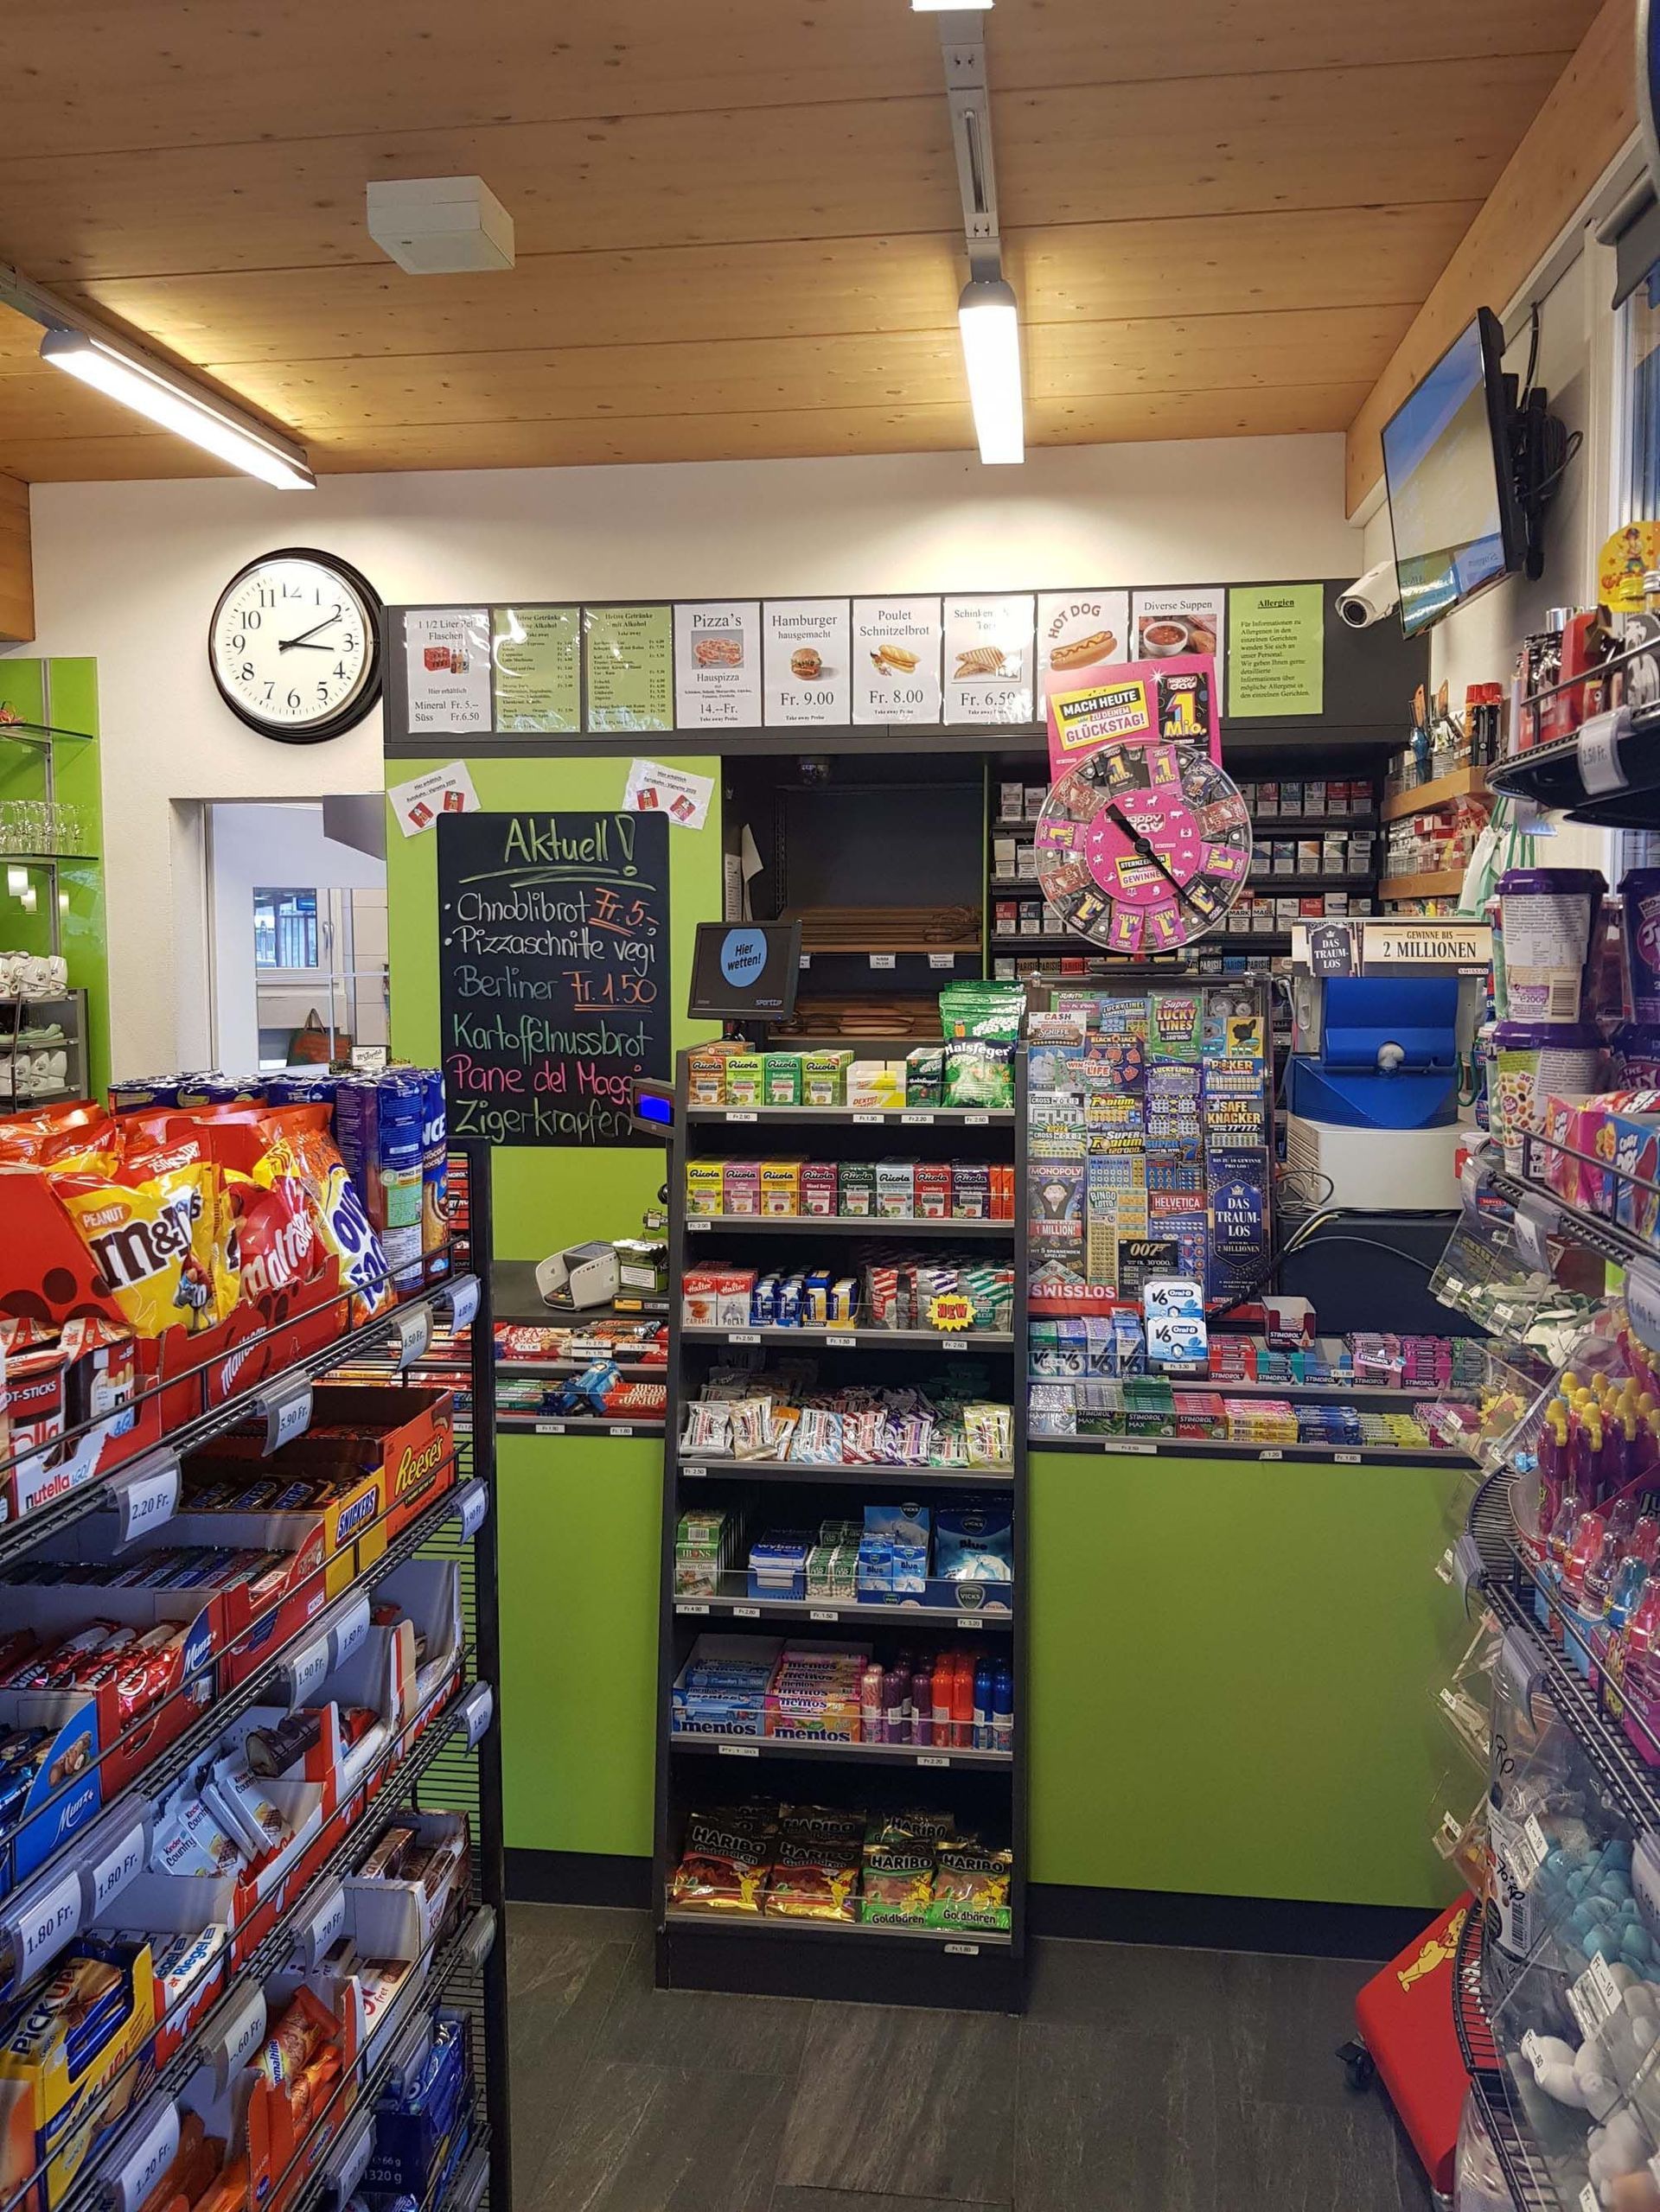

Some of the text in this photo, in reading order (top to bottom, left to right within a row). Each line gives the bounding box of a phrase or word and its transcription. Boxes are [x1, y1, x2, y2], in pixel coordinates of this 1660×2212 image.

[259, 589, 277, 608] 11
[316, 588, 322, 606] 1
[1257, 598, 1294, 609] Allergien
[1144, 600, 1212, 611] Diverse Suppen
[240, 610, 262, 630] 10
[331, 604, 342, 622] 2
[878, 610, 912, 621] Poulet
[693, 613, 742, 628] Pizza's
[772, 614, 838, 628] Hamburger
[1048, 602, 1102, 640] HOT DOG
[429, 631, 464, 641] Flaschen
[778, 630, 831, 641] hausgemacht
[859, 625, 929, 637] Schnitzelbrot
[232, 634, 246, 655] 9
[342, 633, 354, 652] 3
[241, 662, 255, 681] 8
[333, 660, 346, 679] 4
[696, 673, 740, 684] Hauspizza
[264, 681, 276, 700] 7
[316, 681, 329, 701] 5
[869, 691, 923, 704] Fr. 8.00
[287, 688, 301, 709] 6
[415, 700, 446, 711] Mineral
[450, 700, 463, 710] Fr.
[781, 692, 834, 705] Fr. 9.00
[961, 692, 980, 706] Fr.
[1063, 690, 1138, 717] MACH HEUTE
[1165, 692, 1197, 724] 1
[415, 711, 480, 723] Süss Fr.6.50
[1066, 713, 1146, 743] GLÜCKSTAG!
[1165, 718, 1208, 738] Mio.
[1407, 931, 1453, 940] GEWINNE BIS
[735, 942, 754, 957] Hier
[1322, 938, 1340, 949] DAS
[1383, 940, 1477, 959] 2 MILLIONEN
[613, 928, 656, 978] vegi
[1314, 948, 1349, 959] TRAUM-
[727, 953, 761, 972] wetten!
[1324, 958, 1341, 969] LOS
[453, 964, 658, 1004] Berliner Fr. 1.50
[1103, 1001, 1146, 1013] LUCKY LINES
[1163, 999, 1191, 1010] Super
[1044, 1012, 1072, 1021] CASH
[1157, 1008, 1197, 1021] LUCKY
[1159, 1020, 1193, 1031] LINES
[453, 1011, 654, 1066] Kartoffelnussbrot
[945, 1042, 1010, 1060] Halsfeger
[693, 1061, 722, 1071] Ricola
[728, 1060, 759, 1070] Ricola
[767, 1060, 798, 1069] Ricola
[806, 1061, 837, 1071] Ricola
[1067, 1061, 1084, 1069] WIN
[1087, 1067, 1110, 1076] LIFE
[445, 1053, 526, 1093] Pane
[533, 1060, 567, 1094] del
[1220, 1100, 1248, 1112] SAFE
[1207, 1112, 1262, 1125] KNACKER
[1107, 1131, 1141, 1139] SUPER
[689, 1169, 720, 1178] Ricola
[1031, 1167, 1082, 1176] MONOPOLY
[1089, 1191, 1117, 1202] BINGO
[1154, 1197, 1201, 1208] HELVETICA
[1228, 1197, 1250, 1209] DAS
[1094, 1200, 1114, 1208] LOTTO
[82, 1206, 124, 1228] PEANUT
[1215, 1211, 1261, 1224] TRAUM-
[1042, 1225, 1076, 1236] MILLION!
[1229, 1225, 1251, 1237] LOS
[1130, 1243, 1160, 1257] 007
[1031, 1284, 1116, 1299] SWISSLOS
[1152, 1289, 1169, 1306] V6
[937, 1303, 968, 1320] NEW
[1155, 1324, 1172, 1343] V6
[1269, 1331, 1302, 1340] STIMOROL
[1359, 1355, 1392, 1366] STIMOROL
[279, 1405, 309, 1432] 5.90 Fr.
[393, 1435, 444, 1496] Reese's
[24, 1476, 71, 1509] nutella
[132, 1493, 169, 1521] 2.20 Fr.
[337, 1485, 377, 1542] SNICKERS
[757, 1543, 803, 1553] wybert
[959, 1539, 988, 1552] Blue
[866, 1565, 884, 1574] Blue
[900, 1561, 919, 1570] Blue
[307, 1592, 325, 1614] MINOR
[297, 1658, 325, 1686] 1.90 Fr.
[788, 1661, 838, 1671] mentos
[680, 1719, 757, 1737] mentos
[775, 1727, 852, 1743] mentos
[163, 1837, 182, 1856] kinder
[692, 1825, 768, 1856] HARIBO
[165, 1835, 197, 1868] Country
[870, 1854, 932, 1870] HARIBO
[98, 1851, 138, 1900] 1.80 Fr.
[872, 1913, 925, 1926] Goldbären
[942, 1909, 997, 1925] Goldbären
[26, 1903, 73, 1956] 1.80 Fr.
[173, 1939, 207, 1977] Riegel
[135, 2143, 171, 2196] 1.20 Fr.
